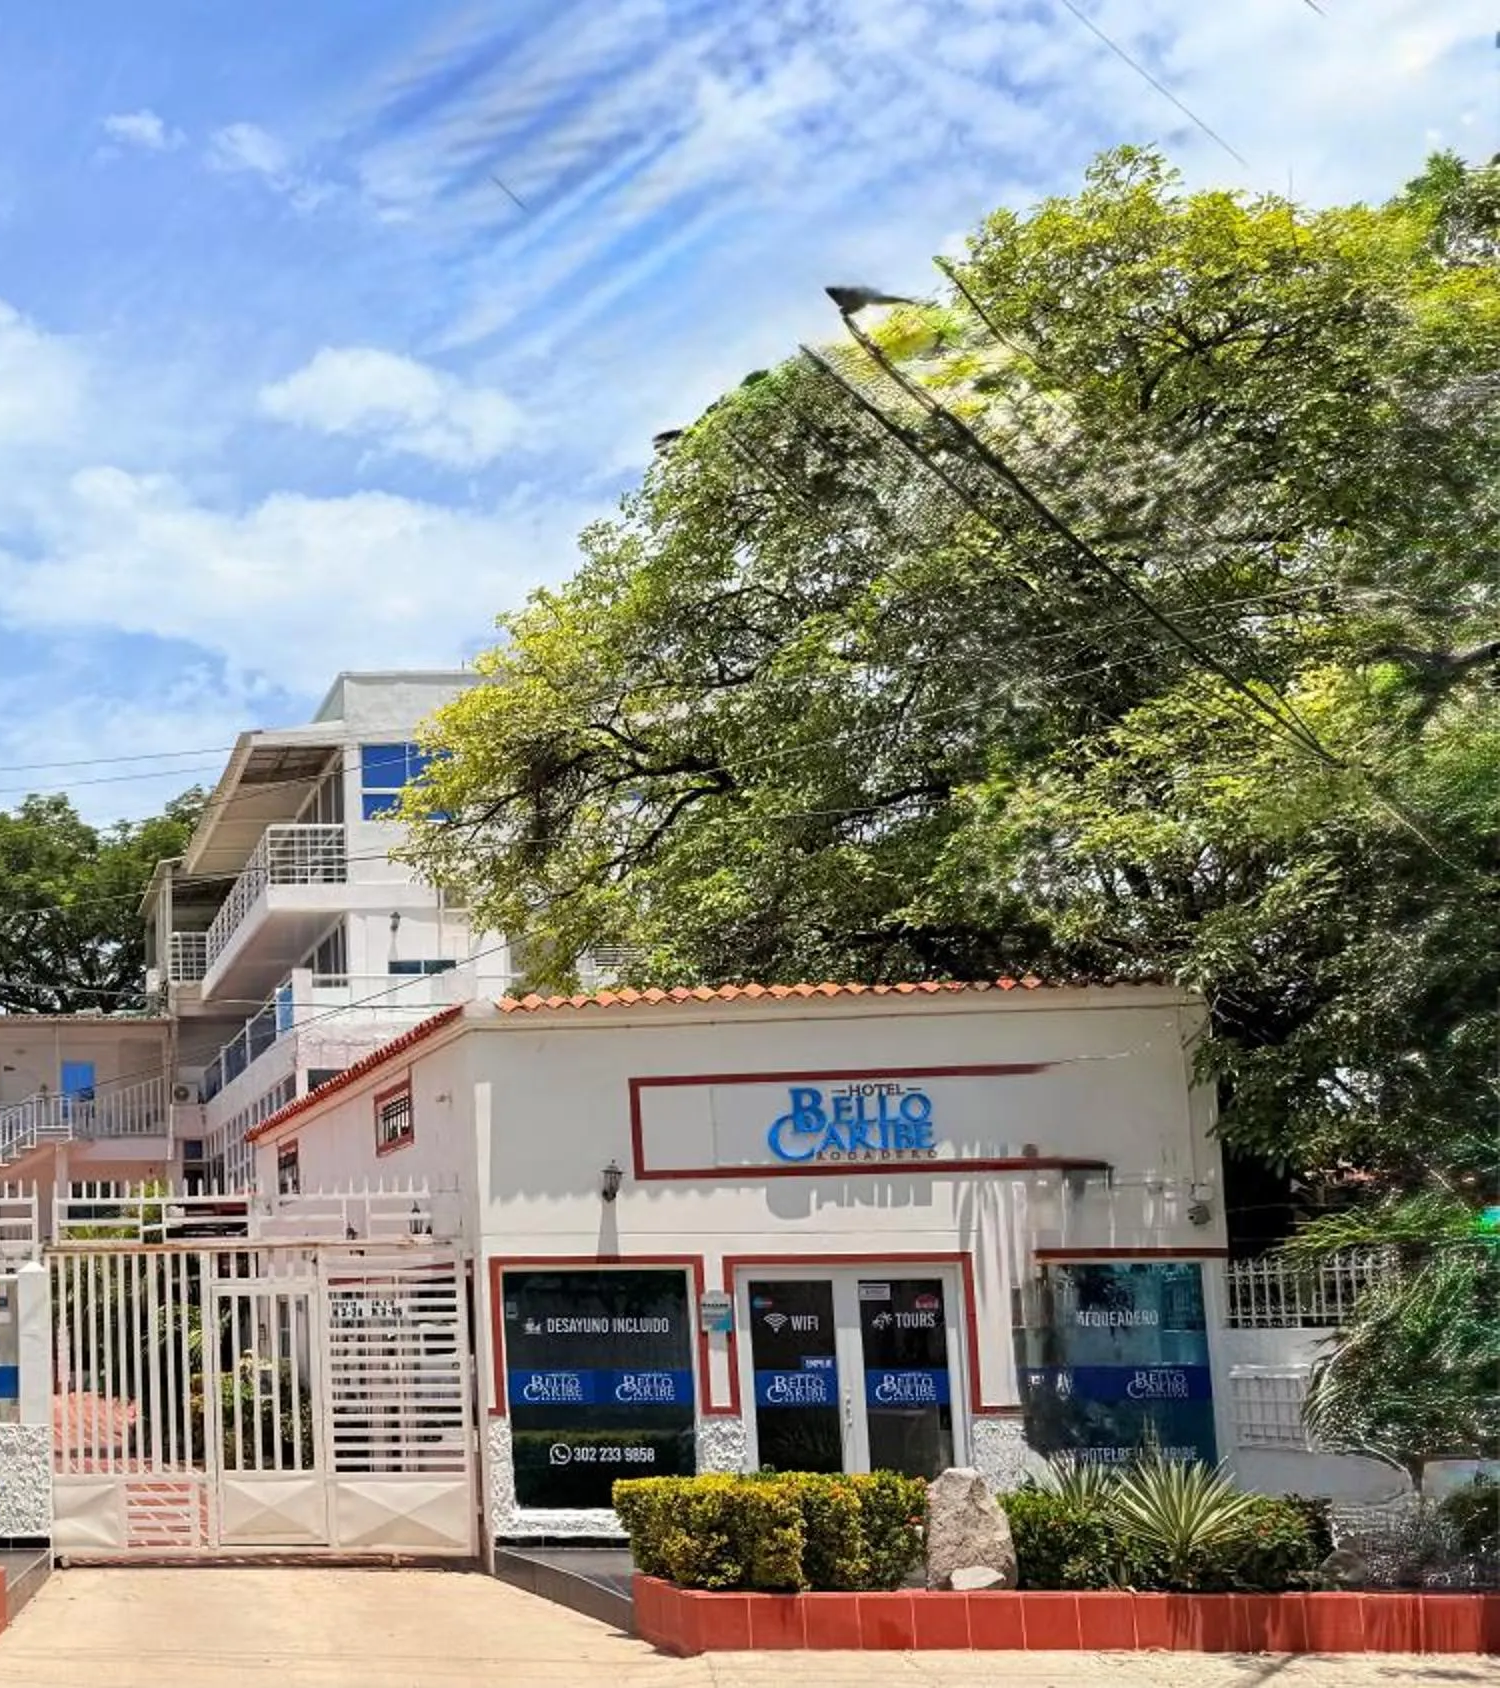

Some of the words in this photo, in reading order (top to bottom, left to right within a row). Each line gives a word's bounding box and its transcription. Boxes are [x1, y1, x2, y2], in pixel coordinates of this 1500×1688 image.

[850, 1083, 905, 1097] HOTEL
[789, 1087, 933, 1132] BELLO
[768, 1114, 937, 1161] CARIBE
[547, 1318, 609, 1333] DESAYUNO
[613, 1318, 669, 1333] INCLUIDO
[791, 1315, 819, 1331] WIFI
[895, 1312, 935, 1328] TOURS
[623, 1374, 674, 1391] BELLO
[774, 1375, 825, 1392] BELLO
[523, 1384, 583, 1400] CARIBE
[615, 1384, 675, 1401] CARIBE
[875, 1384, 937, 1400] CARIBE
[573, 1447, 597, 1461] 302
[599, 1447, 621, 1462] 233
